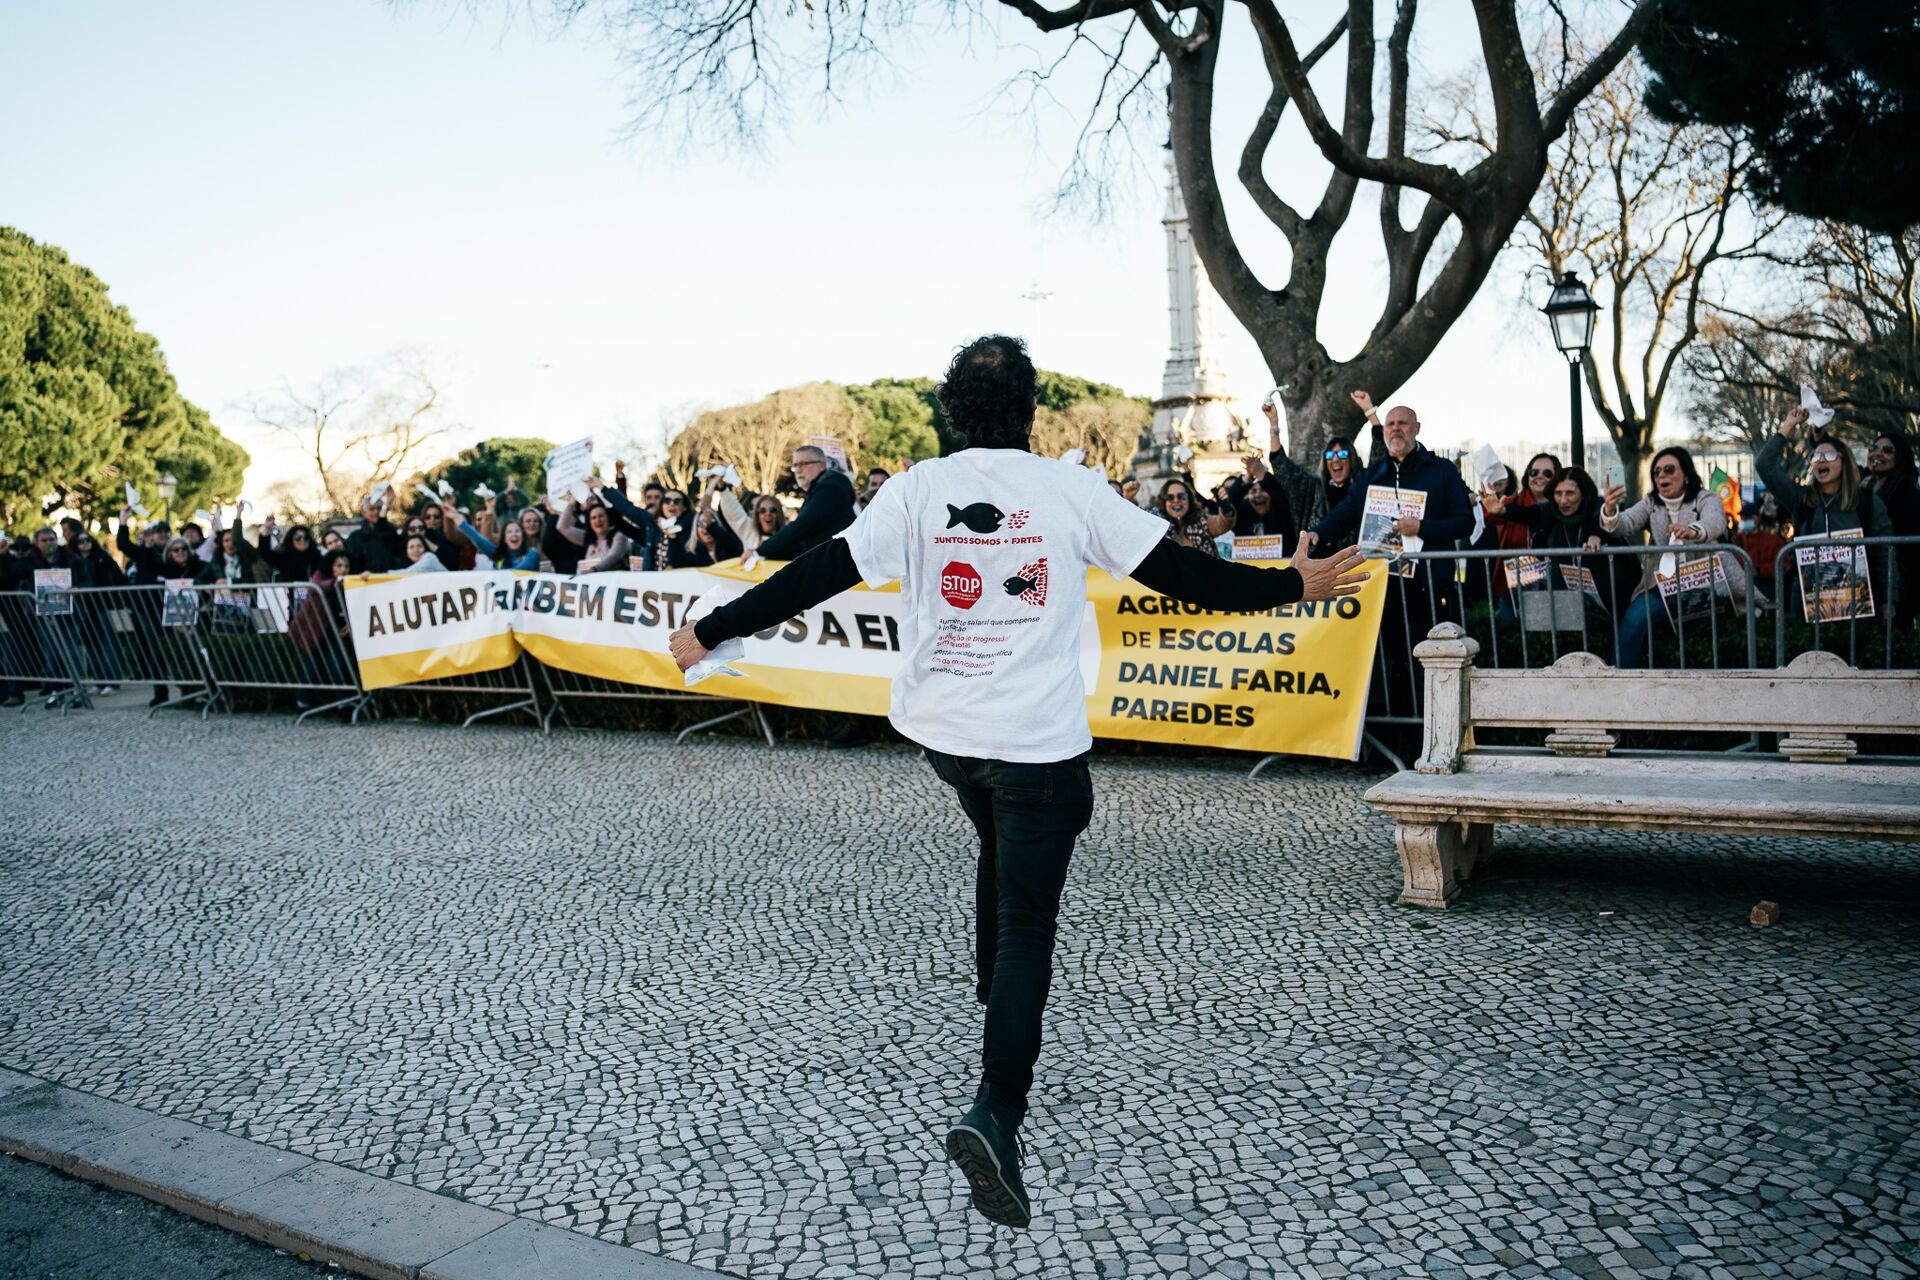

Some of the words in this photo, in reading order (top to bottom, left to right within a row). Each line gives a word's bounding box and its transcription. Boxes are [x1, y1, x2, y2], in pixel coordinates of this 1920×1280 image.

[934, 536, 968, 545] JUNTOS
[969, 538, 1001, 546] SOMOS
[1664, 583, 1687, 596] MAS
[1688, 572, 1724, 589] FORTS
[369, 605, 386, 637] A
[389, 587, 477, 633] LUTAR
[817, 611, 850, 647] A
[1004, 616, 1040, 626] compense
[1122, 631, 1151, 648] DE
[1159, 628, 1296, 656] ESCOLAS
[1118, 662, 1223, 689] DANIEL
[1230, 668, 1340, 699] FARIA,
[1110, 696, 1254, 727] PAREDES
